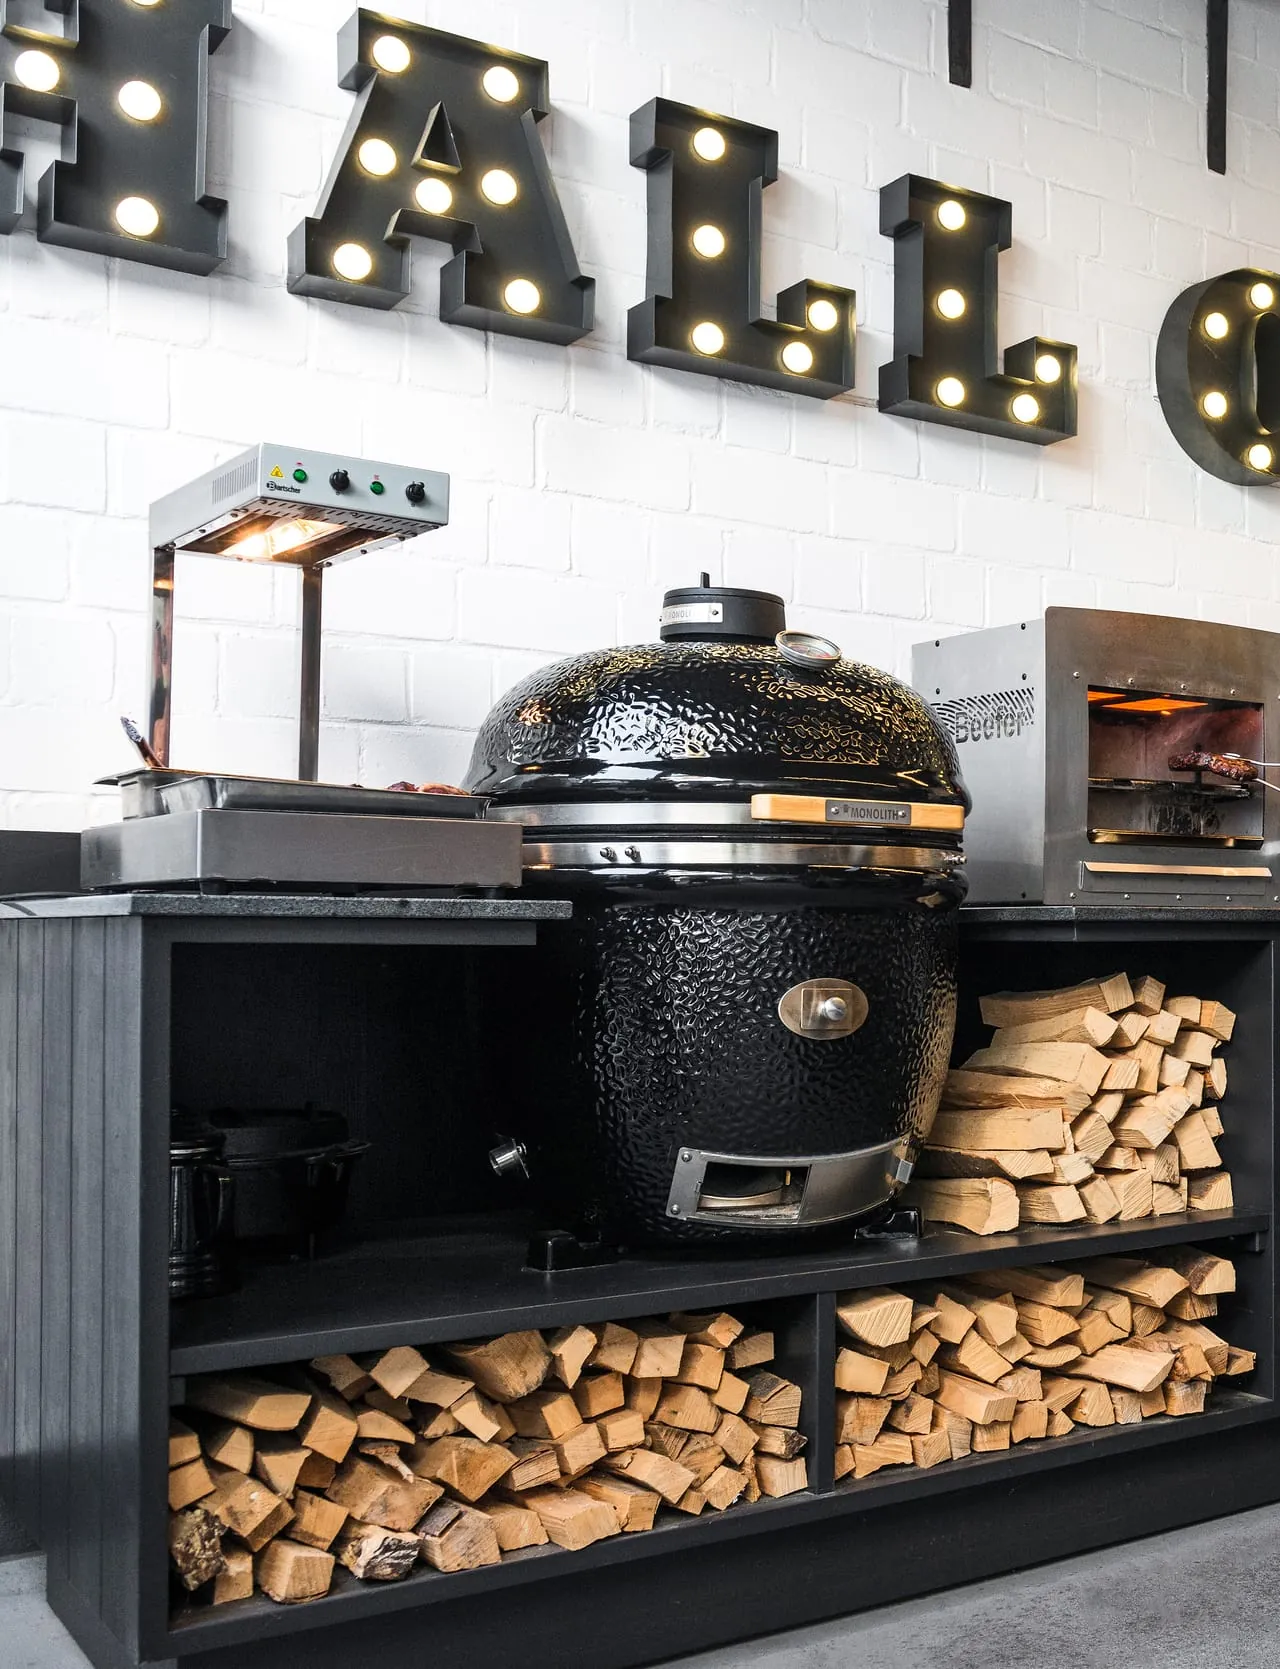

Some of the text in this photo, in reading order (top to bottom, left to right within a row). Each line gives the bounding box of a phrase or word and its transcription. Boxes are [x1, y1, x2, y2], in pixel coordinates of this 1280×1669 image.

[0, 0, 1078, 445] HALL
[955, 704, 1026, 744] Beefer
[851, 807, 900, 821] MONOLITH
